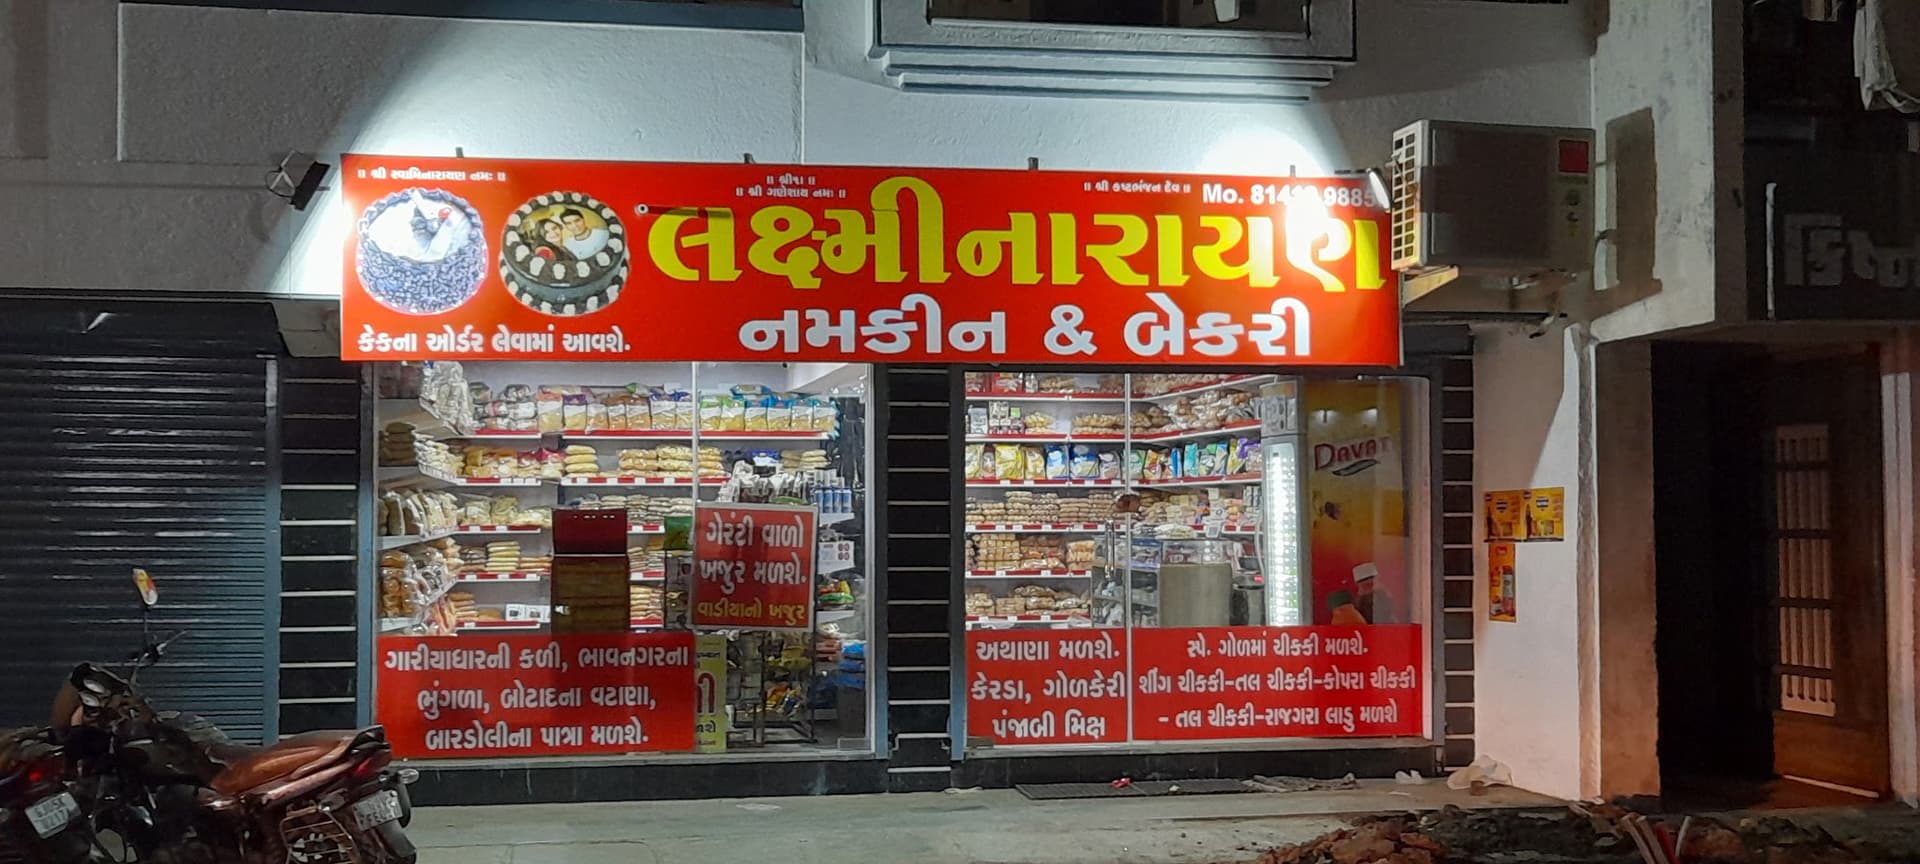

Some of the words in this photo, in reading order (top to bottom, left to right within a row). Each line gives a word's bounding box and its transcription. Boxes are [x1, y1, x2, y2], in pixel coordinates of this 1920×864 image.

[391, 166, 466, 181] સ્વામિનારાયણ
[1203, 183, 1244, 204] Mo.
[648, 177, 1385, 292] લક્ષ્મીનારાયણ
[357, 325, 417, 353] કેકના
[426, 325, 483, 353] ઓર્ડર
[491, 323, 553, 353] લેવામાં
[562, 326, 631, 353] આવશે.
[739, 294, 1006, 355] નમકીન
[1043, 304, 1097, 356] &
[1123, 292, 1311, 356] બેકરી
[706, 512, 753, 546] ગેરંટી
[762, 515, 804, 548] વાળો
[701, 560, 746, 594] ખજુર
[754, 552, 807, 584] મળશે.
[698, 597, 762, 617] વાડીયાનો
[769, 604, 805, 625] ખજુર
[384, 642, 511, 671] ગારીયાધારની
[519, 641, 568, 672] કળી,
[578, 647, 688, 667] ભાવનગરના
[976, 640, 1049, 661] અથાણા
[1059, 631, 1120, 660] મળશે.
[1187, 632, 1211, 658] સ્પે.
[1218, 630, 1266, 657] ગોળમાં
[1325, 630, 1368, 655] મળશે.
[971, 671, 1032, 705] કેરડા,
[1043, 669, 1125, 699] ગોળકેરી
[1139, 667, 1171, 694] શીંગ
[417, 680, 490, 720] ભુંગળા,
[500, 679, 581, 708] બોટાદના
[590, 686, 656, 710] વટાણા,
[1175, 710, 1202, 728] તલ
[1325, 707, 1355, 733] લાડુ
[1360, 697, 1398, 723] મળશે
[425, 719, 532, 750] બારડોલીના
[540, 726, 583, 747] પાત્રા
[591, 716, 648, 745] મળશે.
[992, 709, 1055, 738] પંજાબી
[1065, 708, 1105, 739] મિક્ષ
